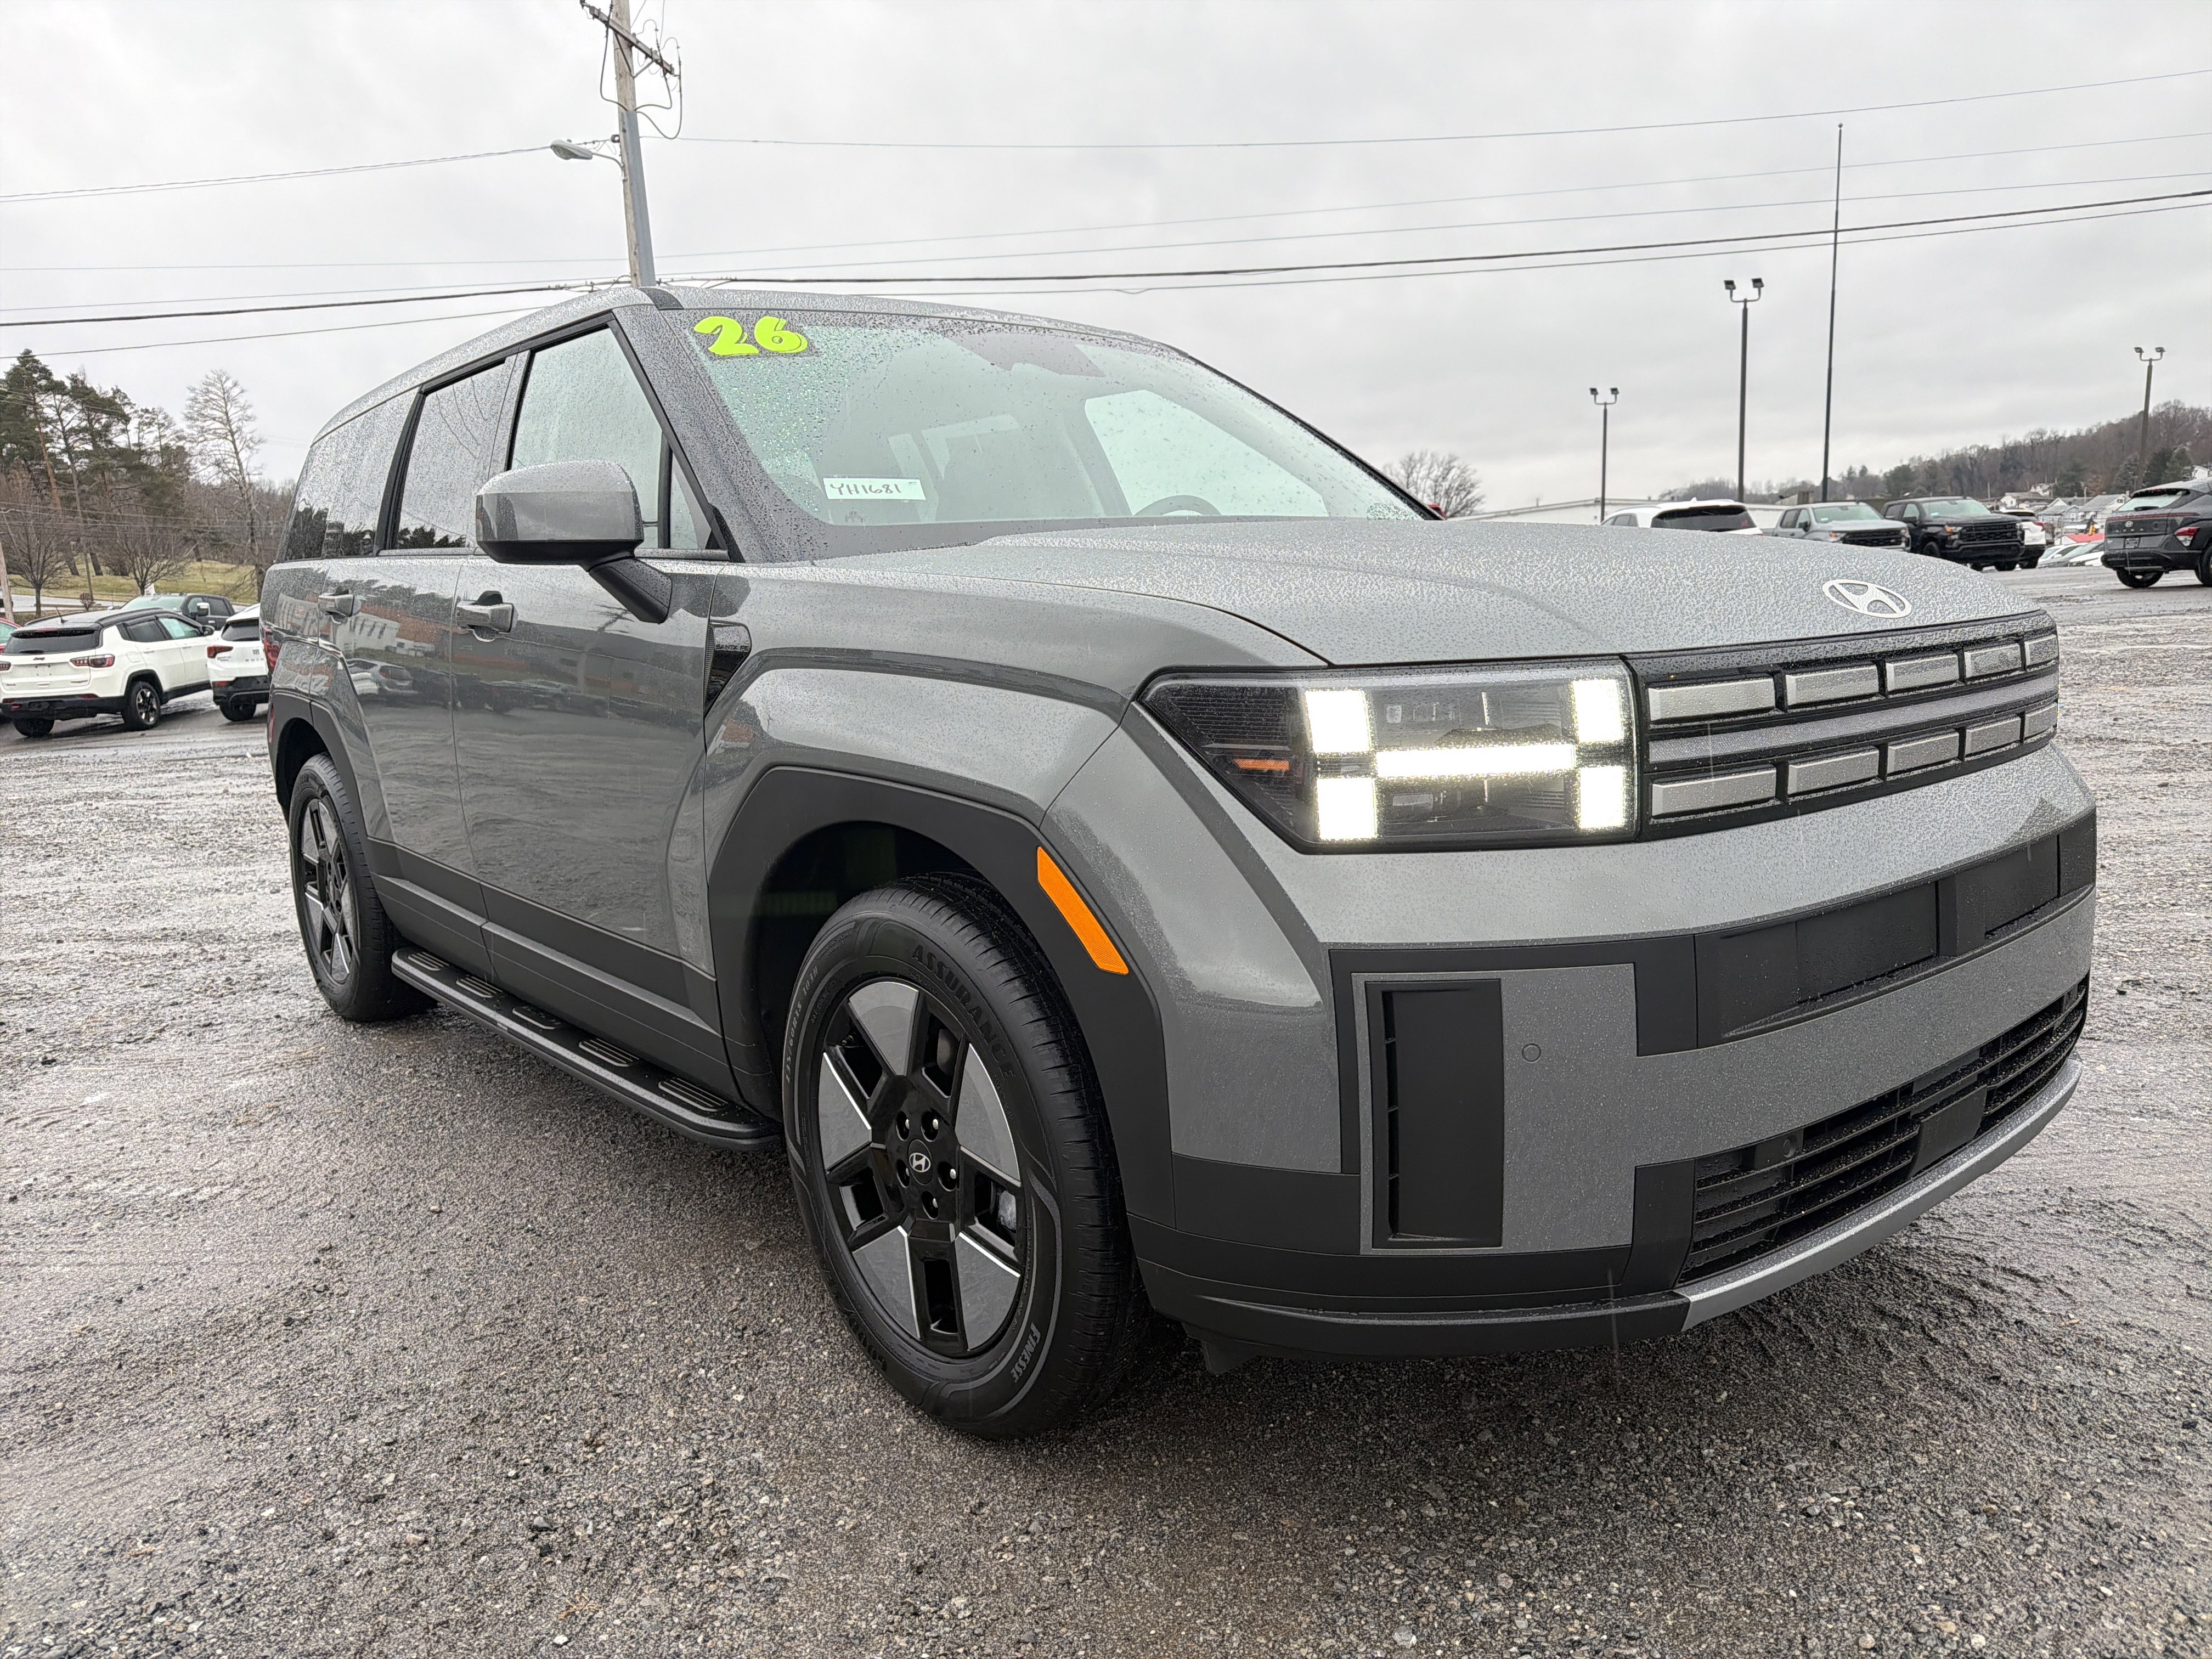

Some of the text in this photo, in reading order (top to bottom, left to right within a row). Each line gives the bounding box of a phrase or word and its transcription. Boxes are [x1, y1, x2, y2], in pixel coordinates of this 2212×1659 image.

[694, 316, 808, 356] 26
[830, 483, 901, 495] YH1681
[911, 944, 1016, 1080] ASSURANCE
[1010, 1322, 1041, 1383] FINESSE
